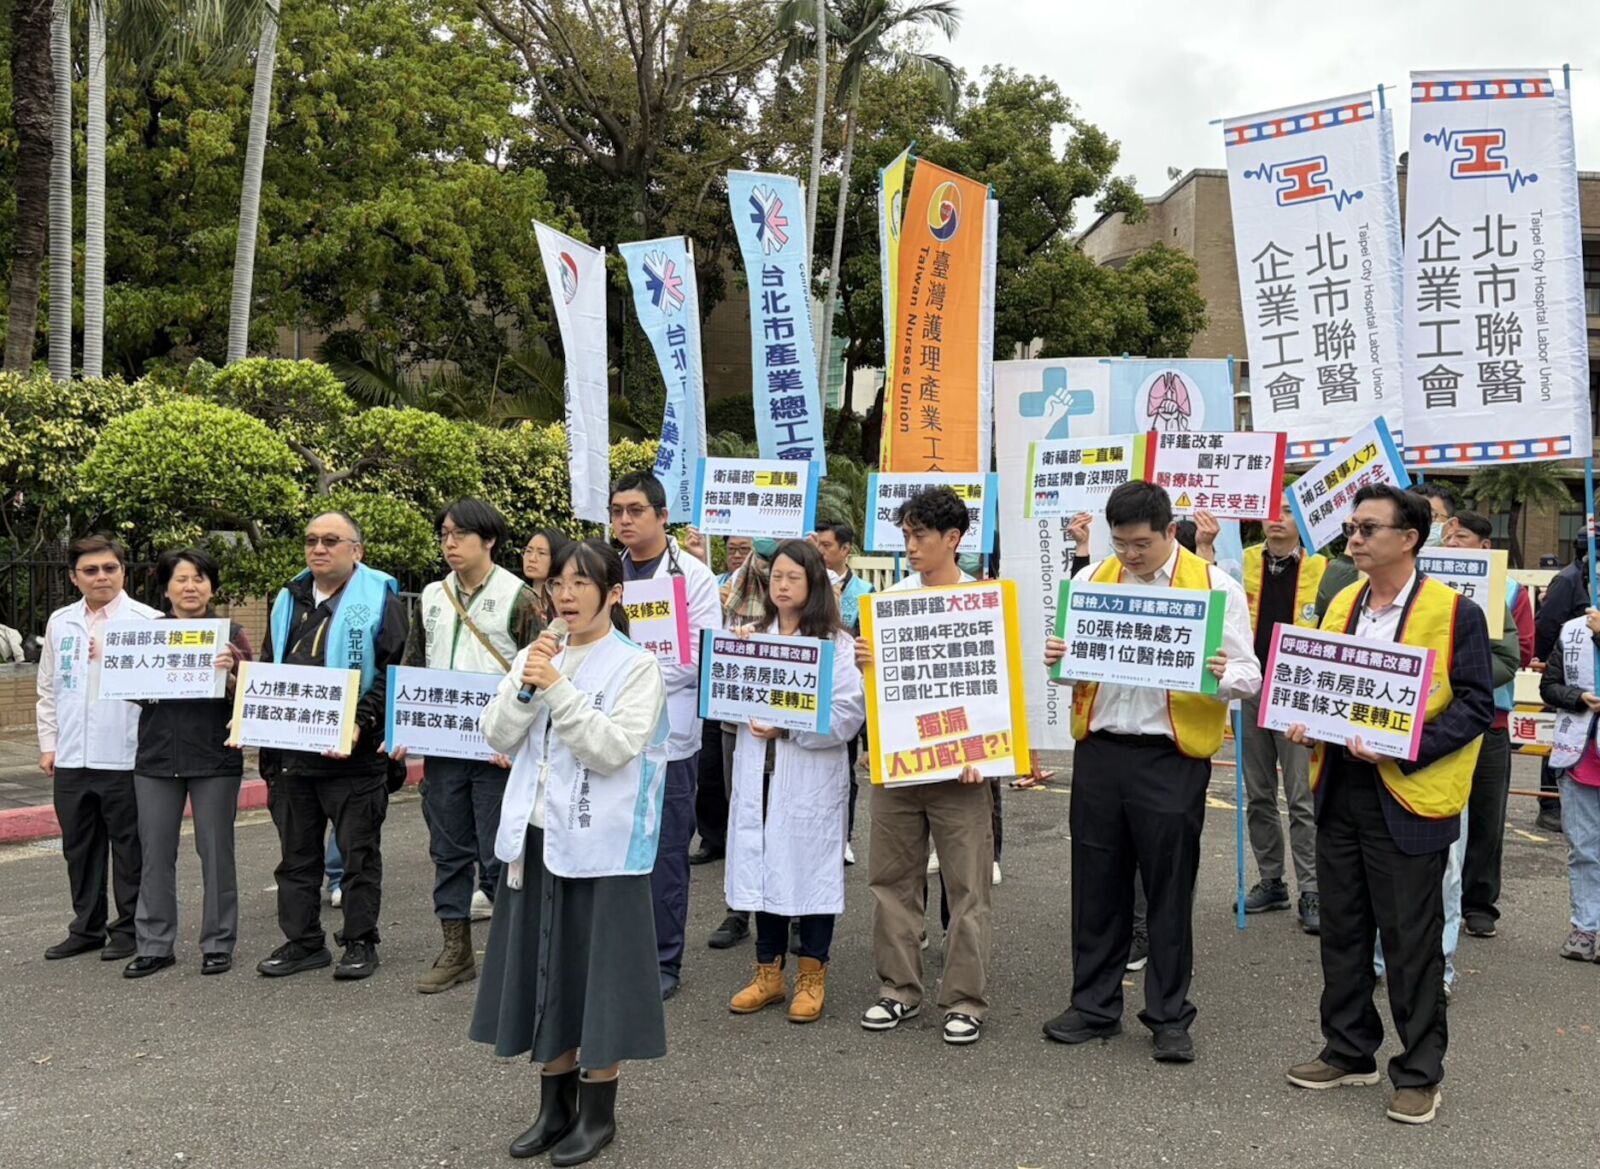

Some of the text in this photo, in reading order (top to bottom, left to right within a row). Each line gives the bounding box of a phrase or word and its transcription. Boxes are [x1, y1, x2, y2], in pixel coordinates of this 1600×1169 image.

[1358, 222, 1383, 400] Taipei City Hospital Labor Union
[1416, 217, 1464, 409] 企業工會
[1472, 214, 1526, 405] 北市聯醫
[1530, 209, 1551, 401] Taipei City Hospital Labor Union
[1251, 241, 1305, 413] 企業工會
[1305, 232, 1360, 405] 北市聯醫
[900, 246, 930, 433] Taiwan Nurses Union
[1160, 433, 1224, 449] 評鑑改革
[1042, 446, 1123, 466] 衛福部一直騙
[1197, 453, 1271, 470] 圖利了誰?
[713, 469, 798, 486] 衛福部一直騙
[1034, 469, 1128, 488] 拖延開會沒期限
[1156, 472, 1219, 488] 醫療缺工
[705, 490, 802, 508] 拖延開會沒期限
[1194, 492, 1266, 509] 全民受苦!
[876, 591, 999, 618] 醫療評鑑大改革
[1072, 594, 1124, 611] 醫檢人力
[106, 630, 215, 646] 衛福部長換三輪
[898, 620, 994, 643] 效期4年改6年
[1076, 620, 1192, 645] 50張檢驗處方
[104, 653, 213, 669] 改善人力零進度
[899, 640, 995, 662] 降低文書負擔
[1070, 641, 1195, 669] 增聘1位醫檢師
[901, 660, 997, 681] 導入智慧科技
[245, 680, 342, 701] 人力標準未改善
[396, 685, 497, 707] 人力標準未改
[711, 682, 815, 710] 評鑑條文要轉正
[902, 680, 998, 700] 優化工作環境
[1271, 687, 1411, 732] 評鑑條文要轉正
[916, 706, 968, 739] 獨漏
[1513, 717, 1537, 740] 道
[889, 732, 1010, 777] 人力配置?!
